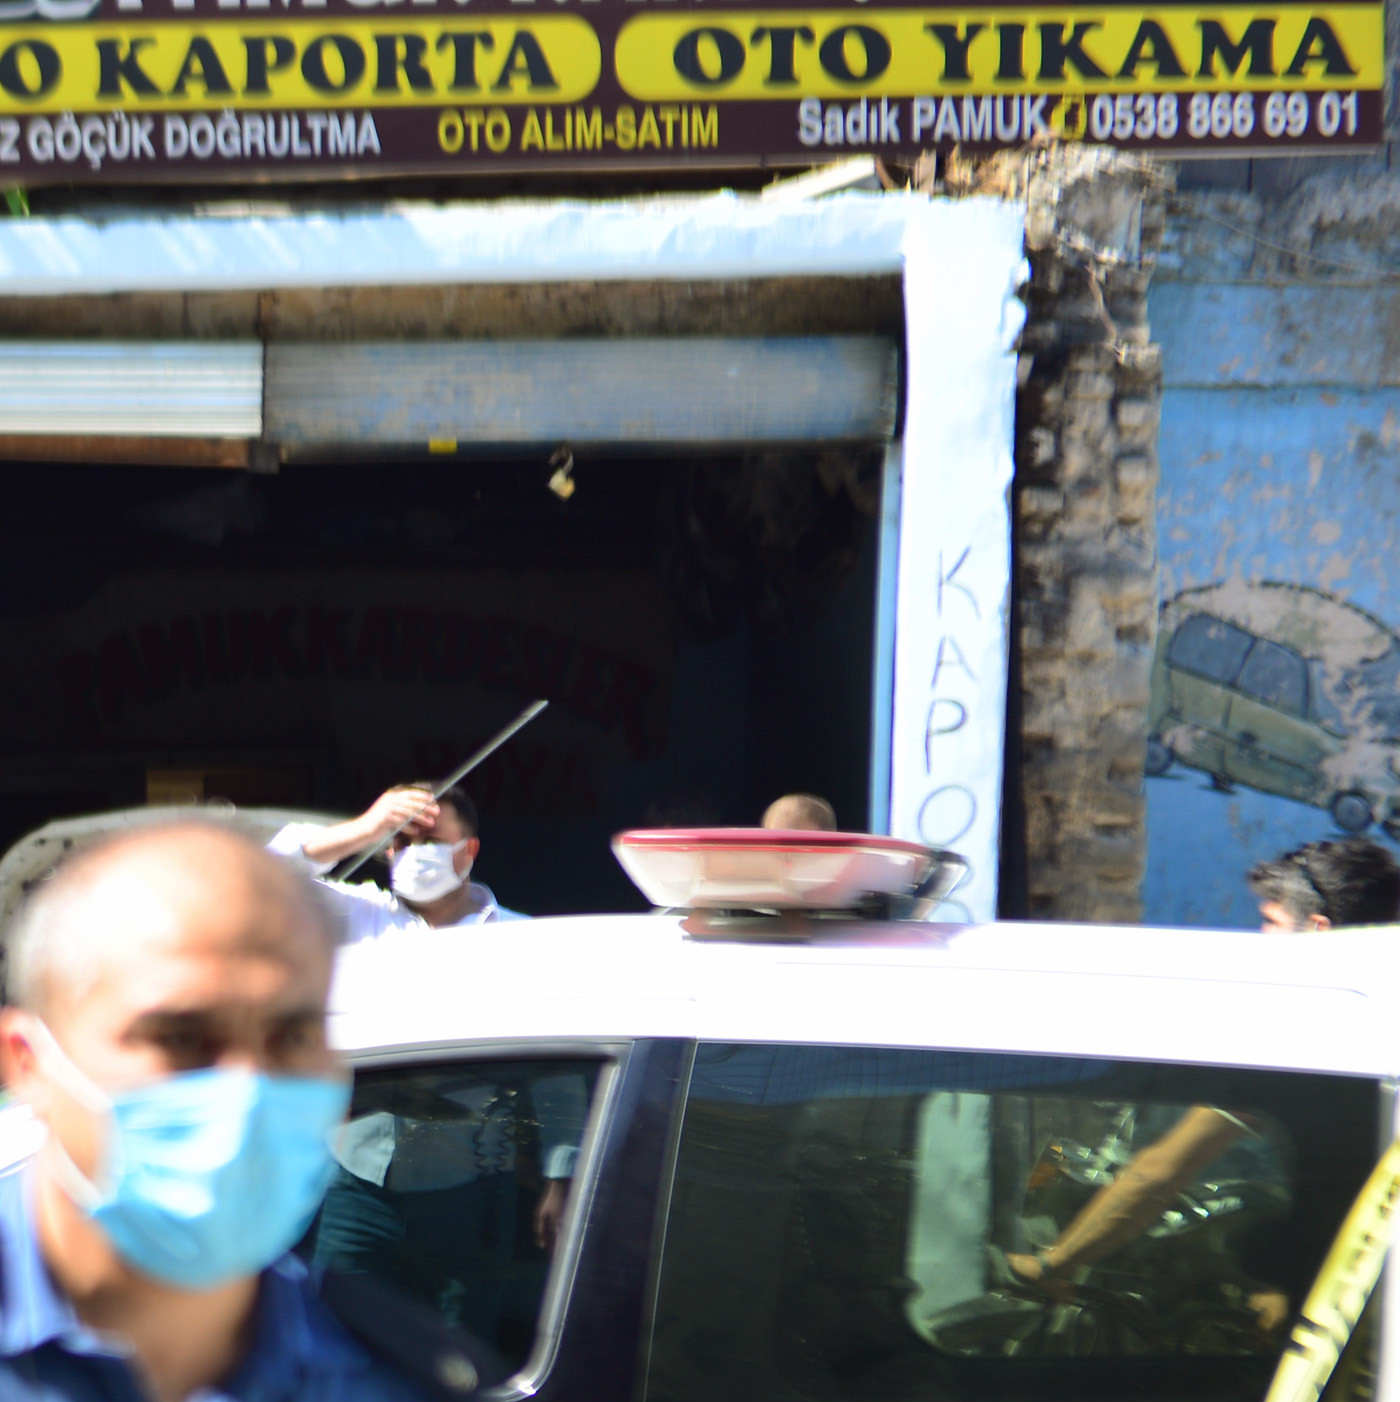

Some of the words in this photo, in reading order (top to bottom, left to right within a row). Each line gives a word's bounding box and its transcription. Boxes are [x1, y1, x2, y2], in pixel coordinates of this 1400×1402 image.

[95, 29, 561, 103] KAPORTA
[672, 23, 893, 90] OTO
[922, 16, 1361, 84] YIKAMA
[27, 109, 156, 169] GÖÇÜK
[165, 105, 382, 160] DOĞRULTMA
[437, 106, 512, 154] OTO
[520, 102, 719, 152] ALIM-SATIM
[911, 92, 1051, 146] PAMUK
[1090, 90, 1180, 141] 0538
[1186, 90, 1256, 139] 866
[1262, 90, 1311, 138] 69
[1315, 89, 1360, 138] 01
